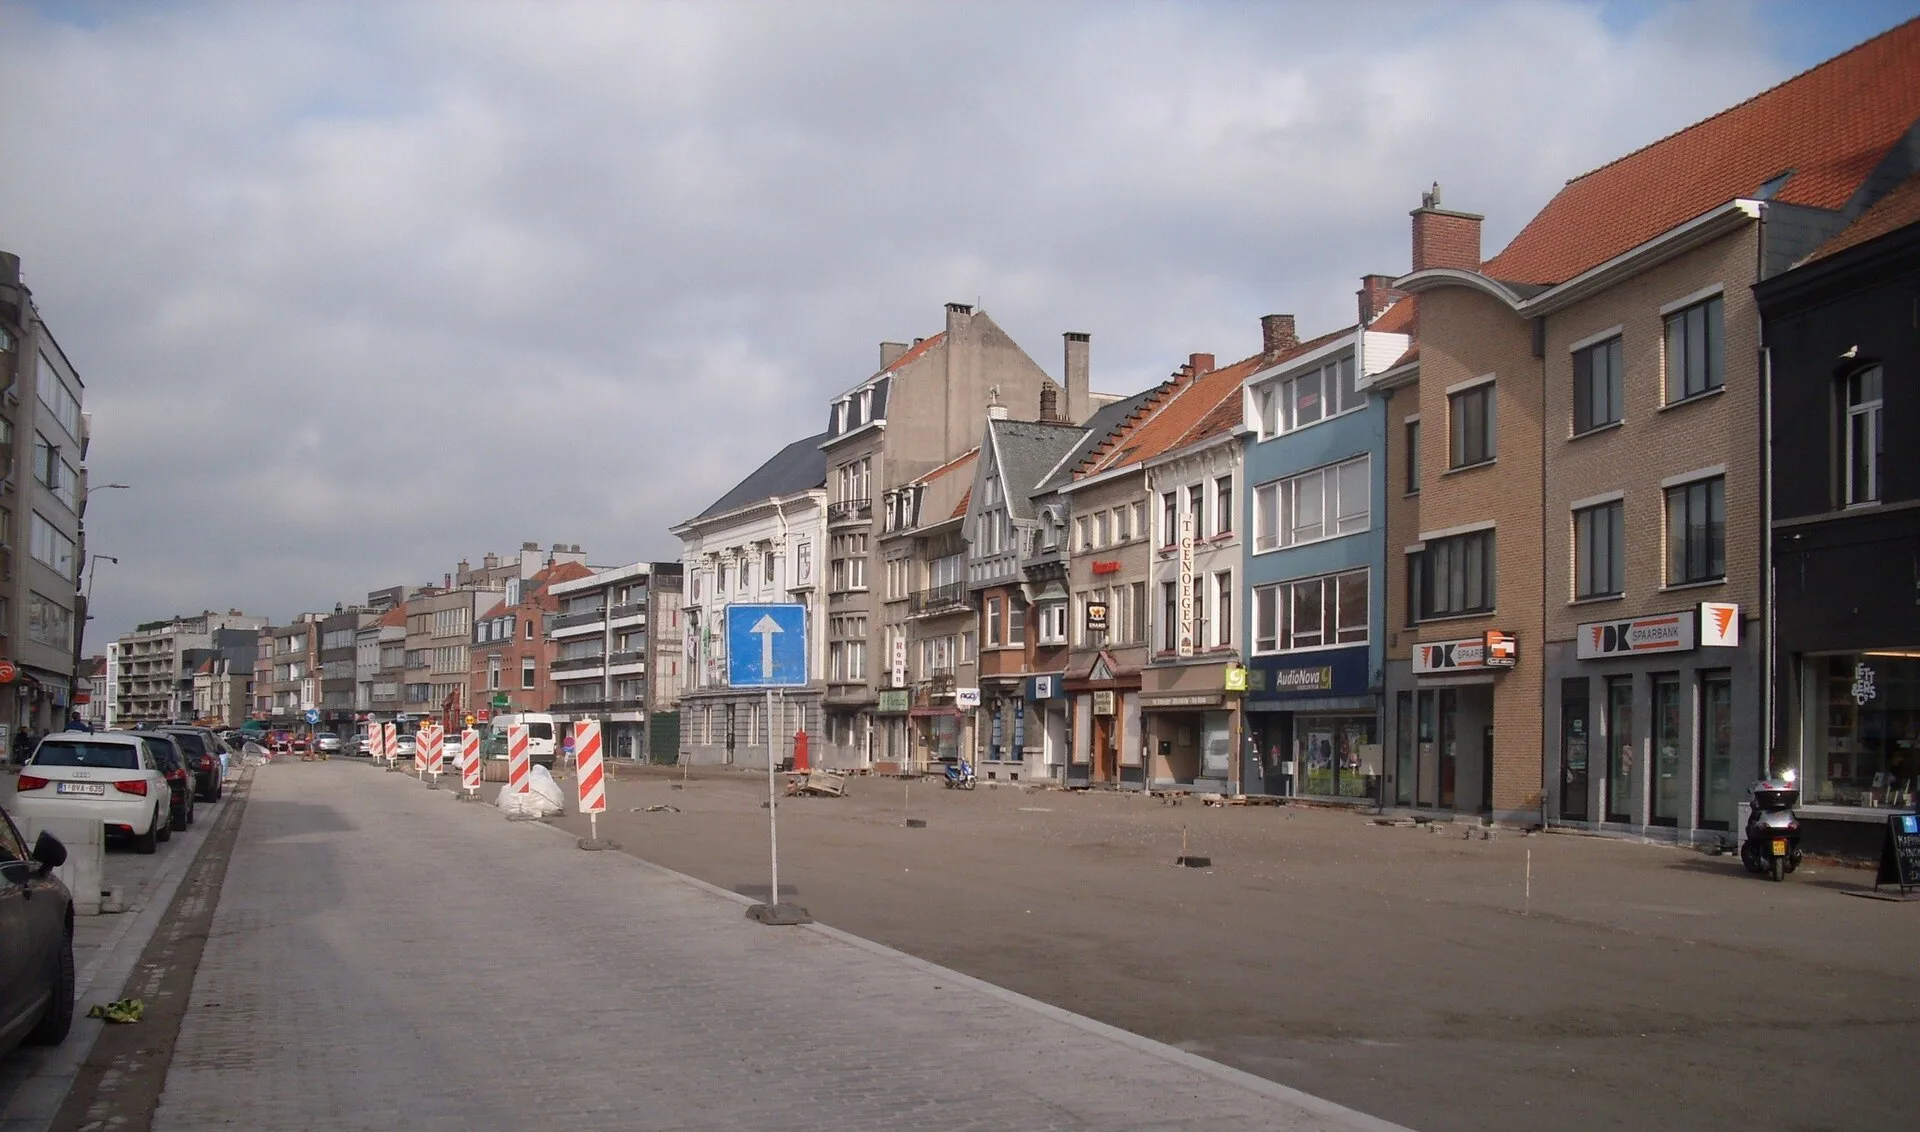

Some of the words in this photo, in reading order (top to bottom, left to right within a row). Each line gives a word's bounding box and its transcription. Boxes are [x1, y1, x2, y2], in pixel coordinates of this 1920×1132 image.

[1181, 537, 1192, 634] GENOEGEN
[1632, 627, 1679, 642] SPAARBANK
[895, 641, 903, 683] Roman
[1276, 669, 1320, 686] AudioNova
